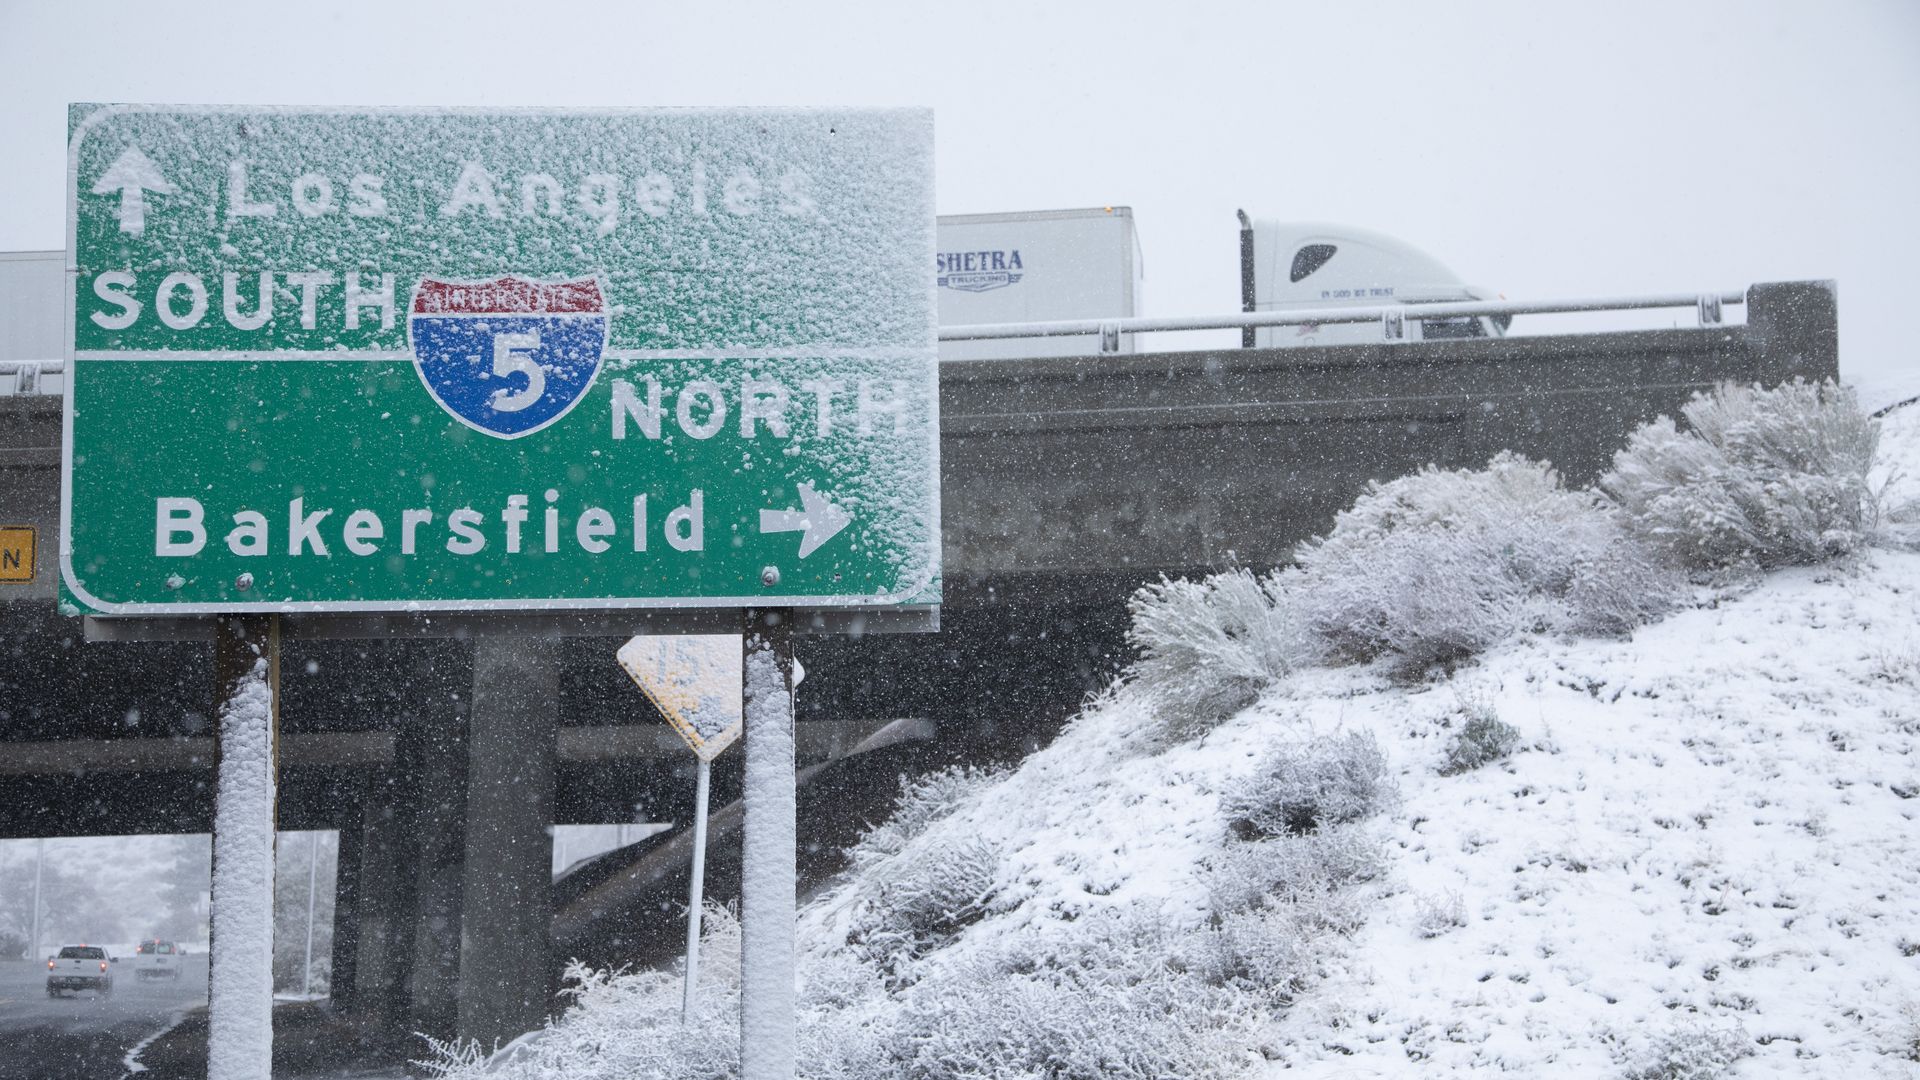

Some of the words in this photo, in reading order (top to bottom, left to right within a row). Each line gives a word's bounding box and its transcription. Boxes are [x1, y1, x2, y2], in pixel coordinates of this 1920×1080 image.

[227, 161, 388, 218] Los
[438, 160, 816, 236] Angeles
[90, 270, 396, 330] SOUTH
[445, 287, 576, 313] INTERSTATE
[950, 275, 1007, 284] TRUCKING
[1370, 287, 1394, 297] TRUST
[491, 331, 546, 412] 5
[611, 377, 910, 440] NORTH
[155, 487, 705, 558] Bakersfield
